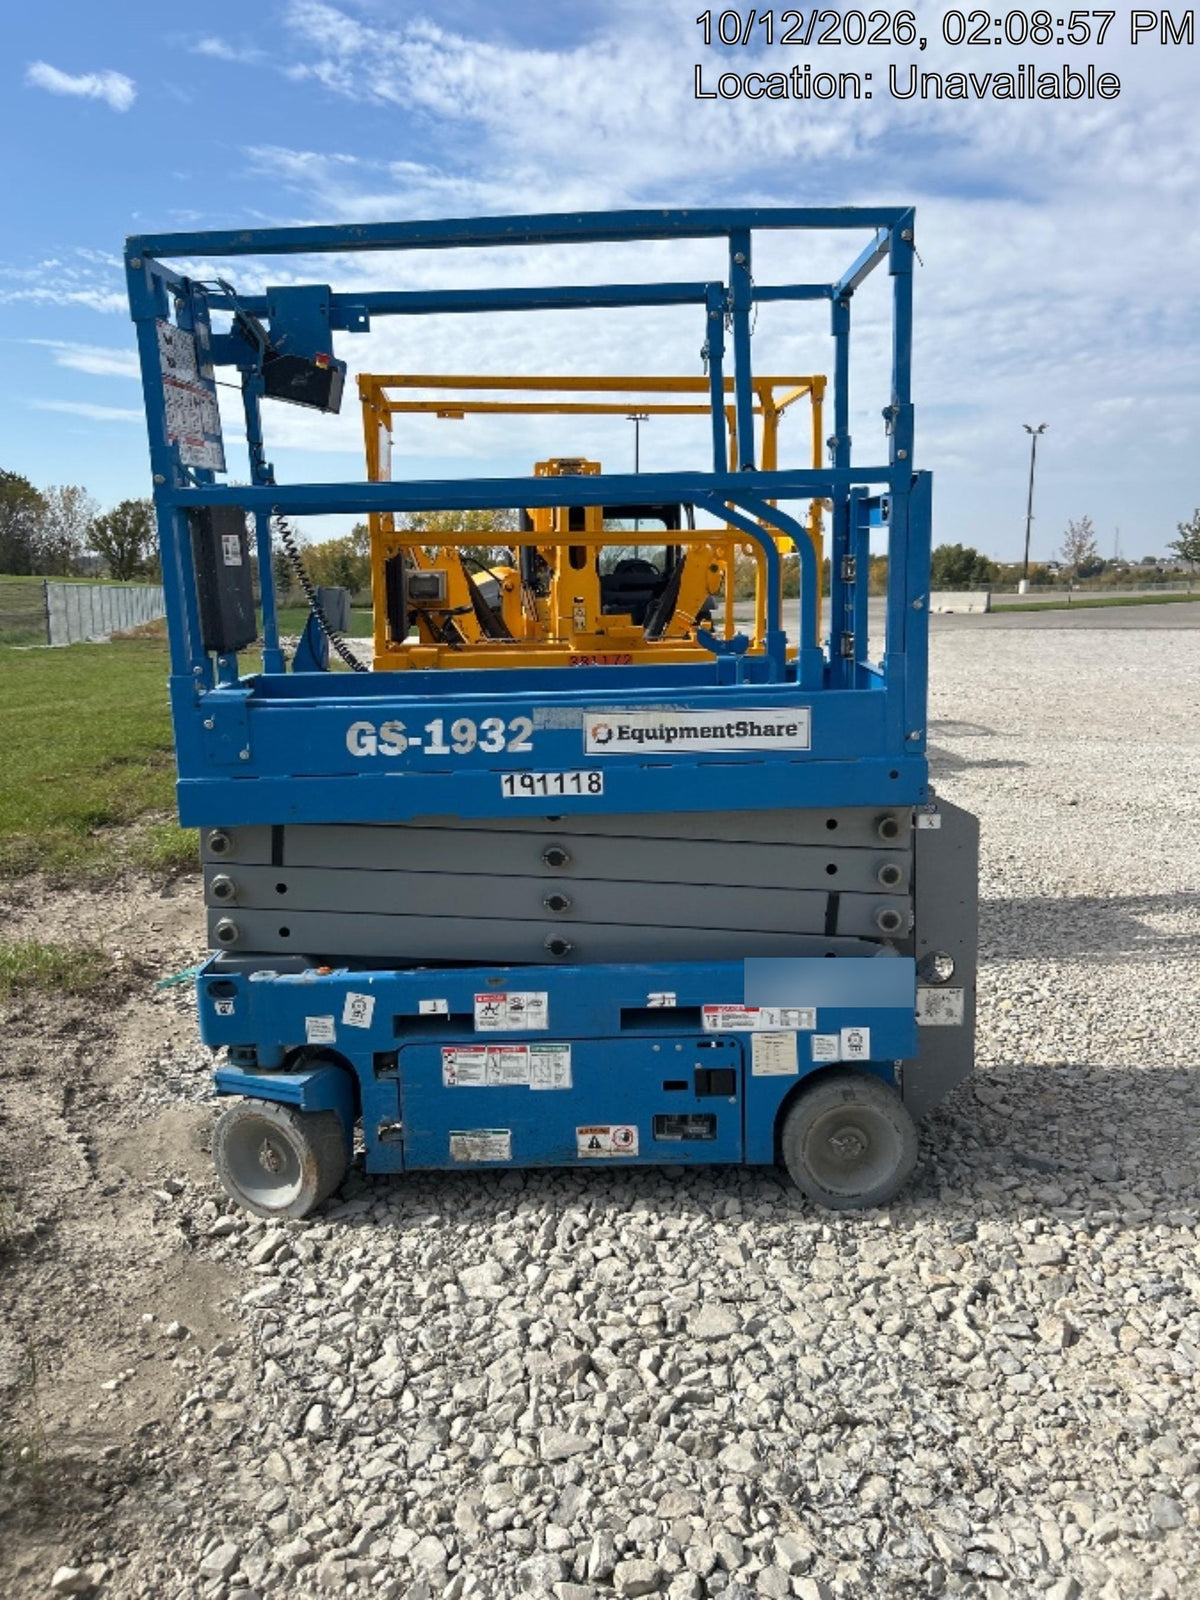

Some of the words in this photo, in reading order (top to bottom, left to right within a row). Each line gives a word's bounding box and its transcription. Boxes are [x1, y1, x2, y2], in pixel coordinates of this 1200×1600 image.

[346, 716, 534, 757] GS-1932
[616, 721, 799, 744] EquipmentShare
[503, 772, 602, 796] 191118
